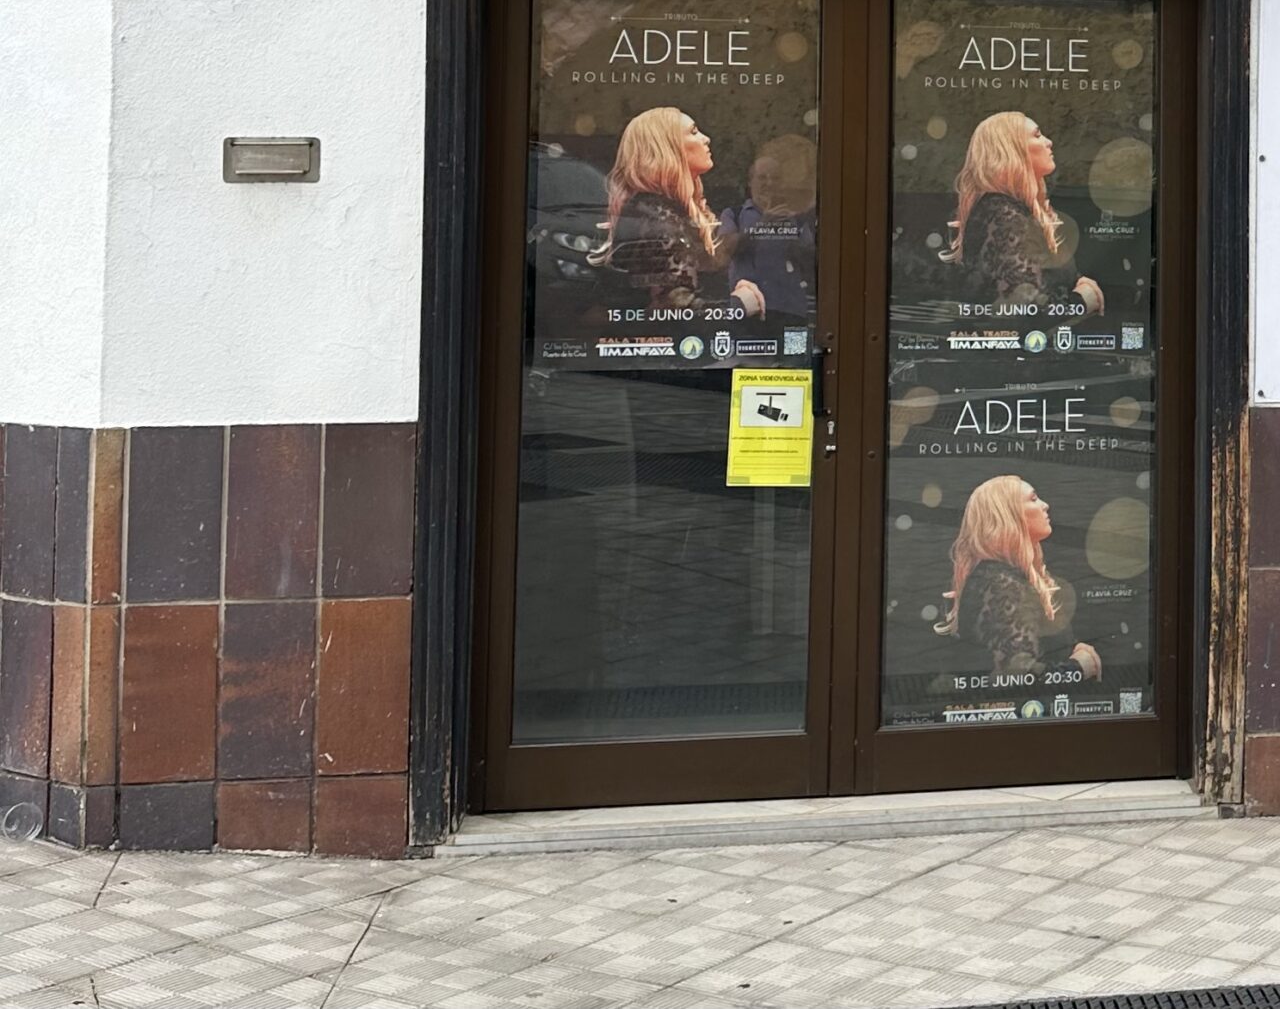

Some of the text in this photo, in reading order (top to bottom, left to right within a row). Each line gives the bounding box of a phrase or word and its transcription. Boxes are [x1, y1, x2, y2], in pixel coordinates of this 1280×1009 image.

[664, 13, 698, 21] TRIBUTO
[609, 29, 750, 66] ADELE
[958, 36, 1089, 72] ADELE
[572, 71, 785, 85] ROLLING IN THE DEEP
[924, 76, 1122, 91] ROLLING IN THE DEEP
[1089, 226, 1114, 234] FLAVIA
[607, 308, 744, 322] 15 DE JUNIO 20:30
[958, 304, 1085, 317] 15 DE JUNIO 20:30
[595, 342, 676, 357] TIMANFAYA
[946, 336, 1022, 350] TIMANFAYA
[954, 398, 1086, 435] ADELE
[919, 438, 1119, 455] ROLLING IN THE DEEP
[1086, 590, 1111, 598] FLAVIA
[954, 671, 1082, 689] 15 DE JUNIO 20:30
[942, 707, 1018, 722] TIMANFAYA
